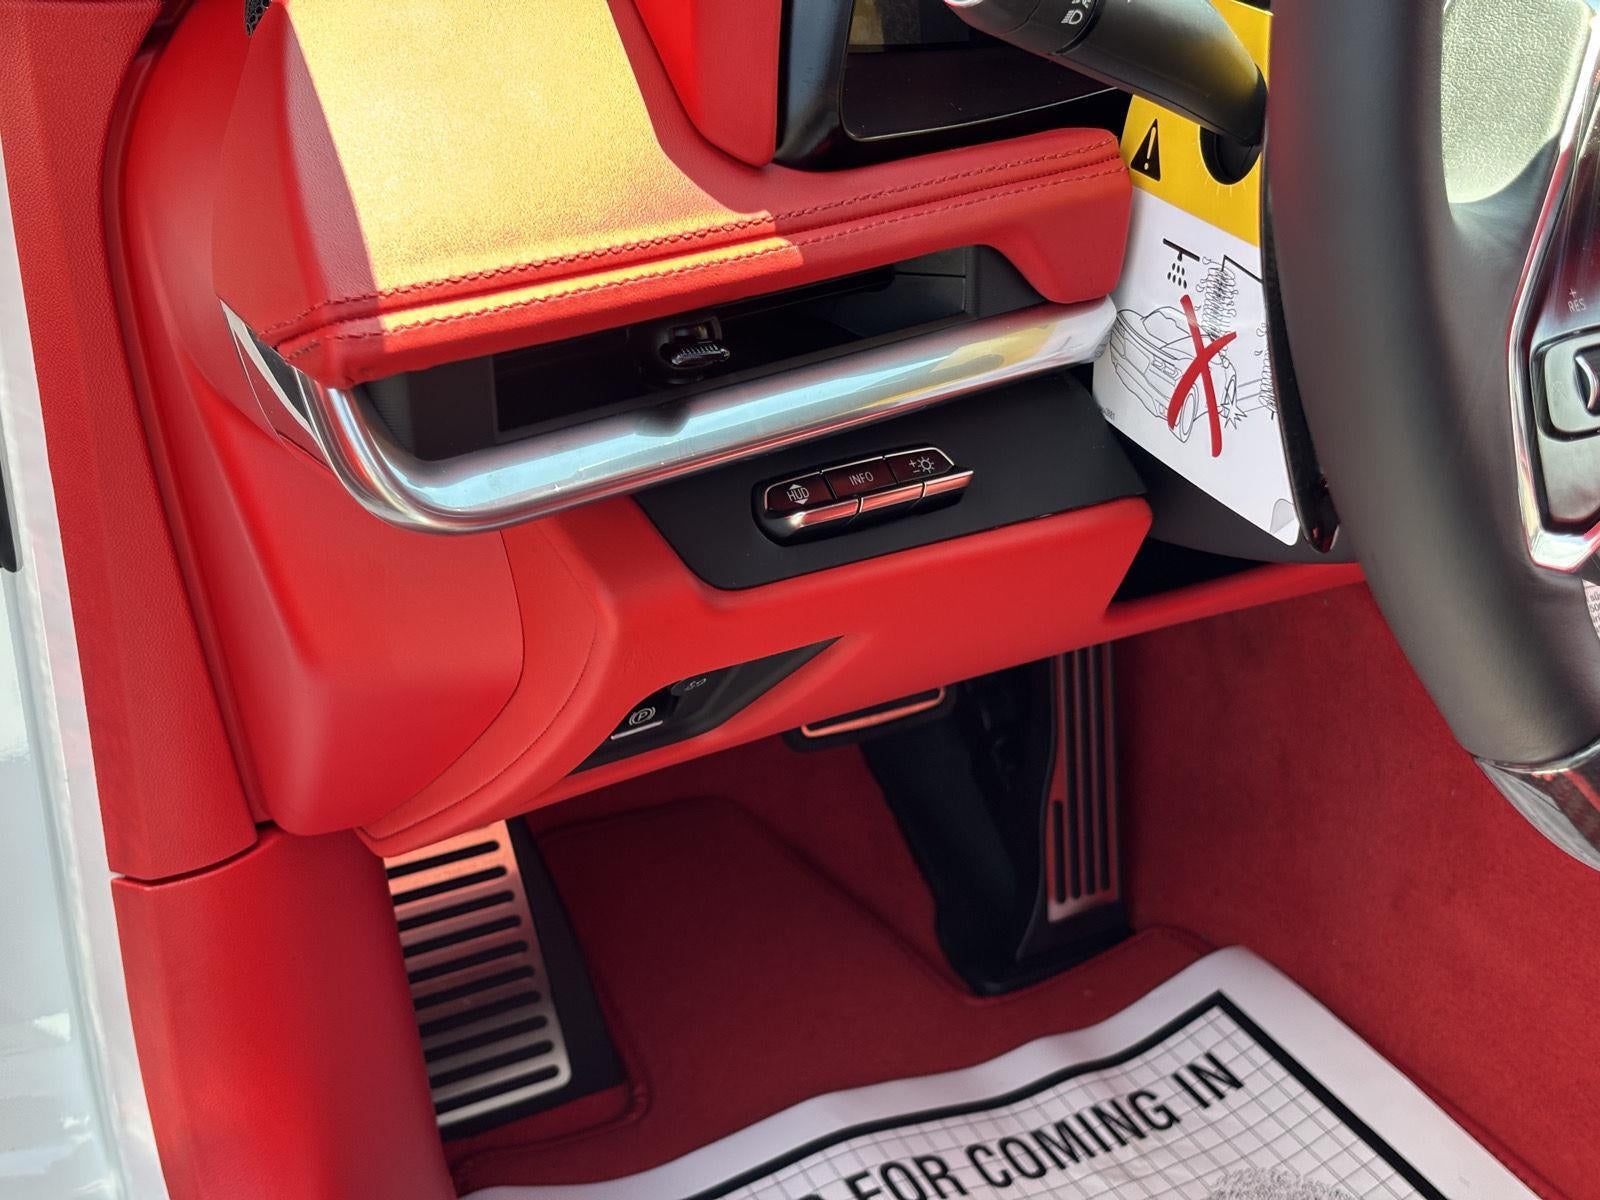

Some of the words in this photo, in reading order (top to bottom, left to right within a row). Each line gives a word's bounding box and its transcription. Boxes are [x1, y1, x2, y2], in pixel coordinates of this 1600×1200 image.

[1568, 298, 1586, 312] RES
[849, 471, 874, 486] INFO
[787, 487, 810, 501] HUD
[845, 1155, 968, 1200] FOR
[965, 1090, 1181, 1188] COMING
[1171, 1051, 1244, 1109] IN
